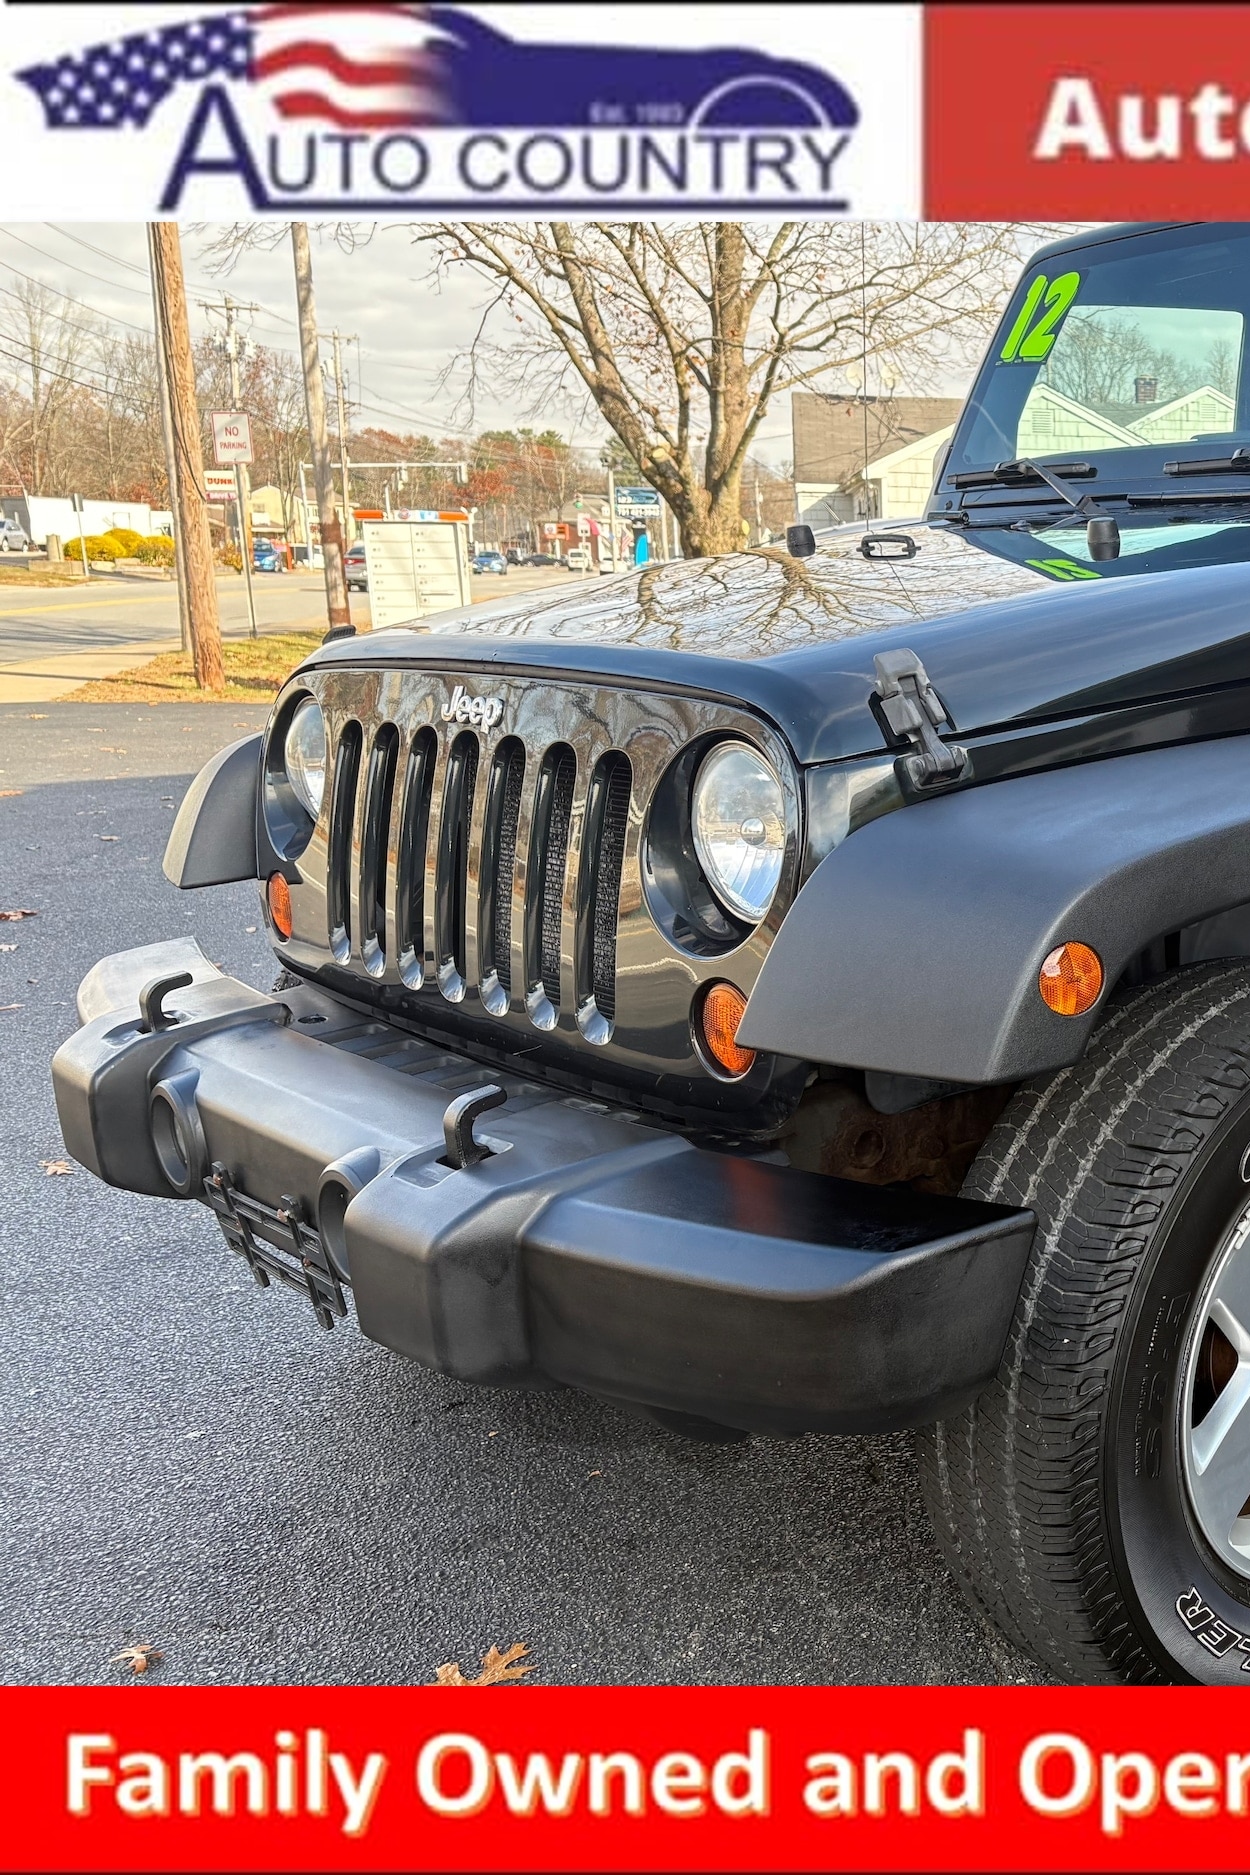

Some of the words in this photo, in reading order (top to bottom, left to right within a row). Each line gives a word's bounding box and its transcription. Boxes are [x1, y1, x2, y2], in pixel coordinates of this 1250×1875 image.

[1000, 272, 1081, 363] 12
[224, 426, 239, 437] NO
[219, 442, 247, 450] PARKING
[207, 477, 233, 485] DUNK
[441, 685, 503, 735] Jeep
